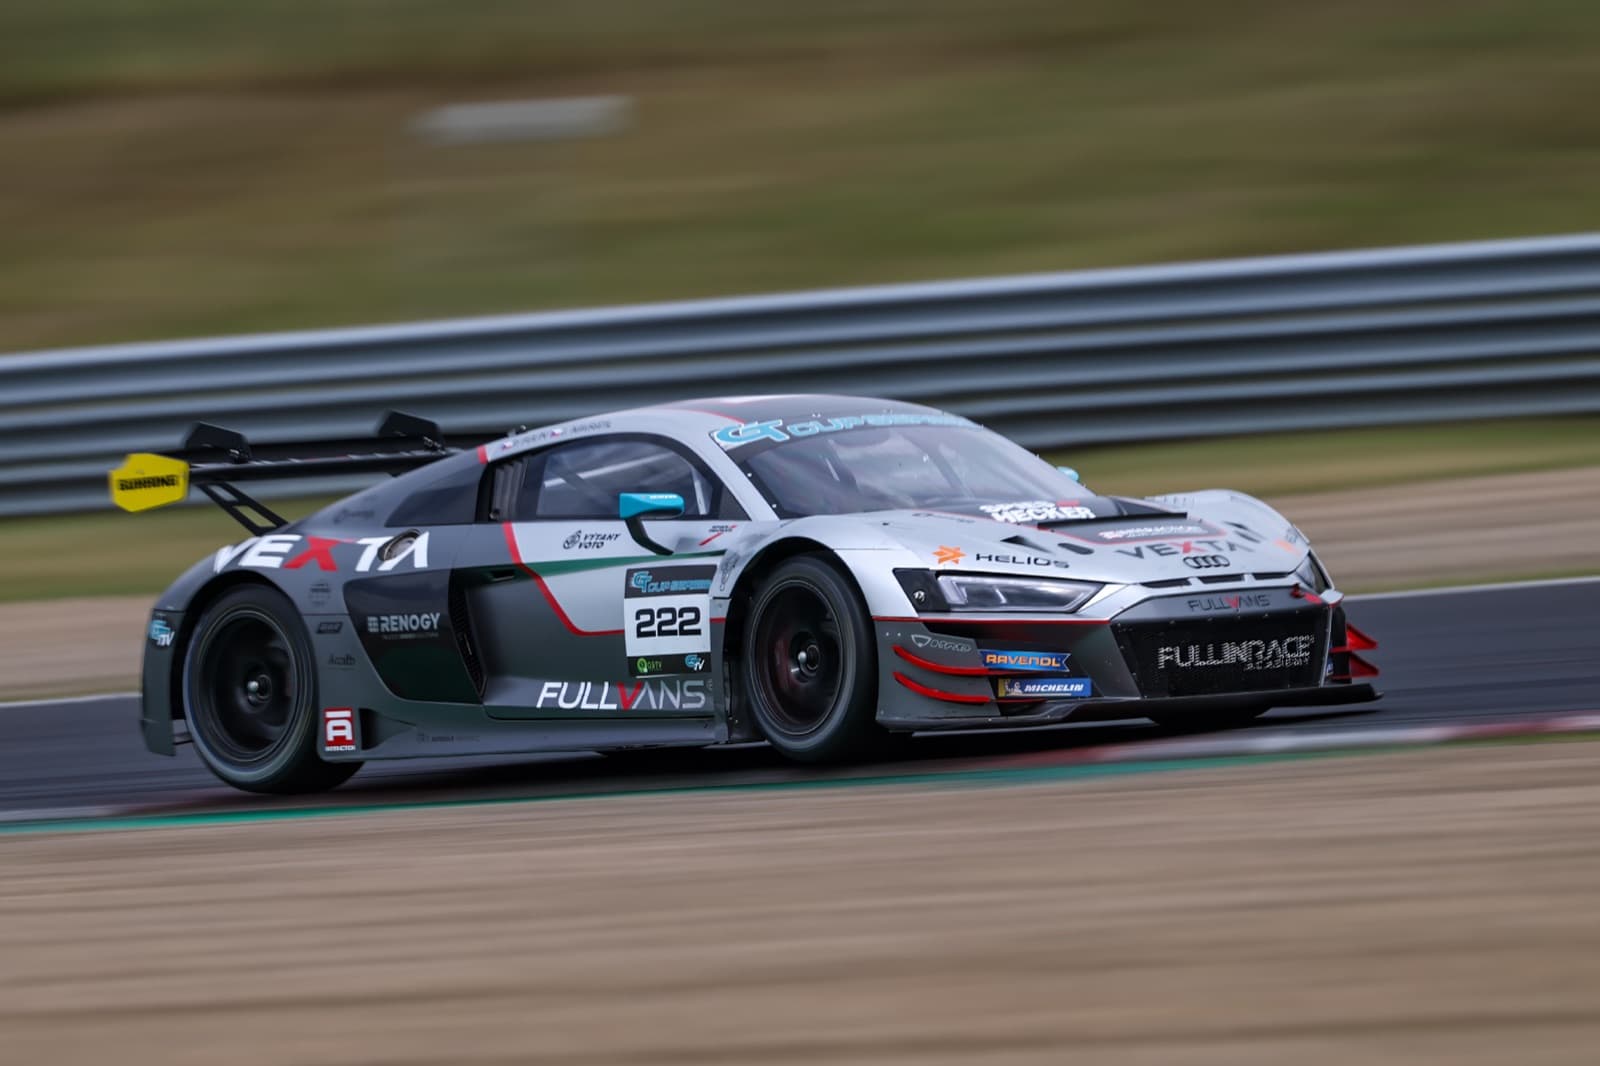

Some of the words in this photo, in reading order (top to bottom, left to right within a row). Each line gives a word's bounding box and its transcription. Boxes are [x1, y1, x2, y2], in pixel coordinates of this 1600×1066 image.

[213, 531, 430, 574] VEXTA
[577, 540, 605, 550] VOTO
[1114, 540, 1255, 560] VEXTA
[975, 552, 1071, 570] HELIOS
[1187, 594, 1271, 612] FULLVANS
[379, 611, 441, 633] RENOGY
[635, 606, 702, 639] 222
[985, 653, 1062, 668] RAVENOL
[535, 679, 706, 711] FULLVANS
[1023, 683, 1085, 694] MICHELIN
